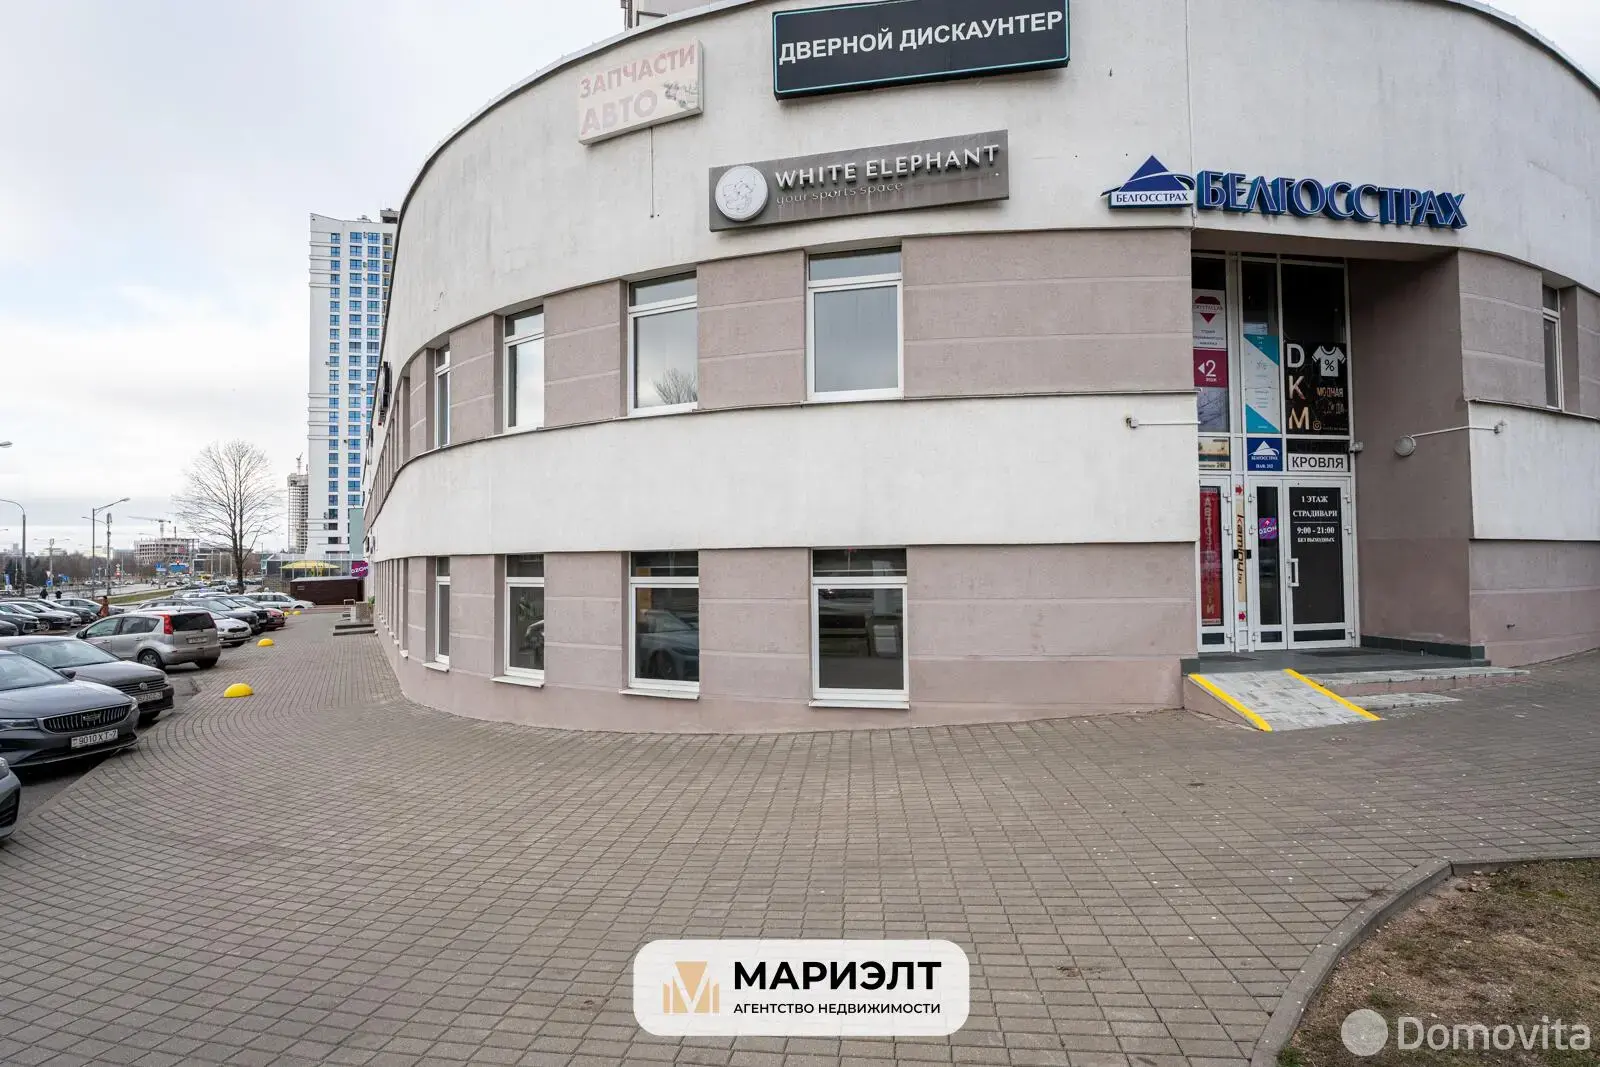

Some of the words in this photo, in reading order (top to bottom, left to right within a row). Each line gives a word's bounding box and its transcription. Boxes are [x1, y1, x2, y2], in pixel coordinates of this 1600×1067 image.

[779, 28, 894, 65] ДВЕРНОЙ
[899, 11, 1063, 50] ДИСКАУНТЕР
[580, 44, 695, 100] ЗАПЧАСТИ
[581, 89, 658, 136] АВТО
[776, 162, 857, 191] WHITE
[866, 144, 1000, 178] ELEPHANT
[776, 191, 809, 206] your
[811, 187, 857, 202] sports
[860, 182, 904, 198] space
[1115, 191, 1189, 204] БЕЛГОССТРАХ
[1196, 170, 1467, 229] БЕЛГОССТРАХ
[1205, 359, 1217, 377] 2
[1292, 456, 1344, 469] КРОВЛЯ
[1292, 510, 1338, 518] СТРАДИВАРИ
[1297, 527, 1312, 535] 9:00
